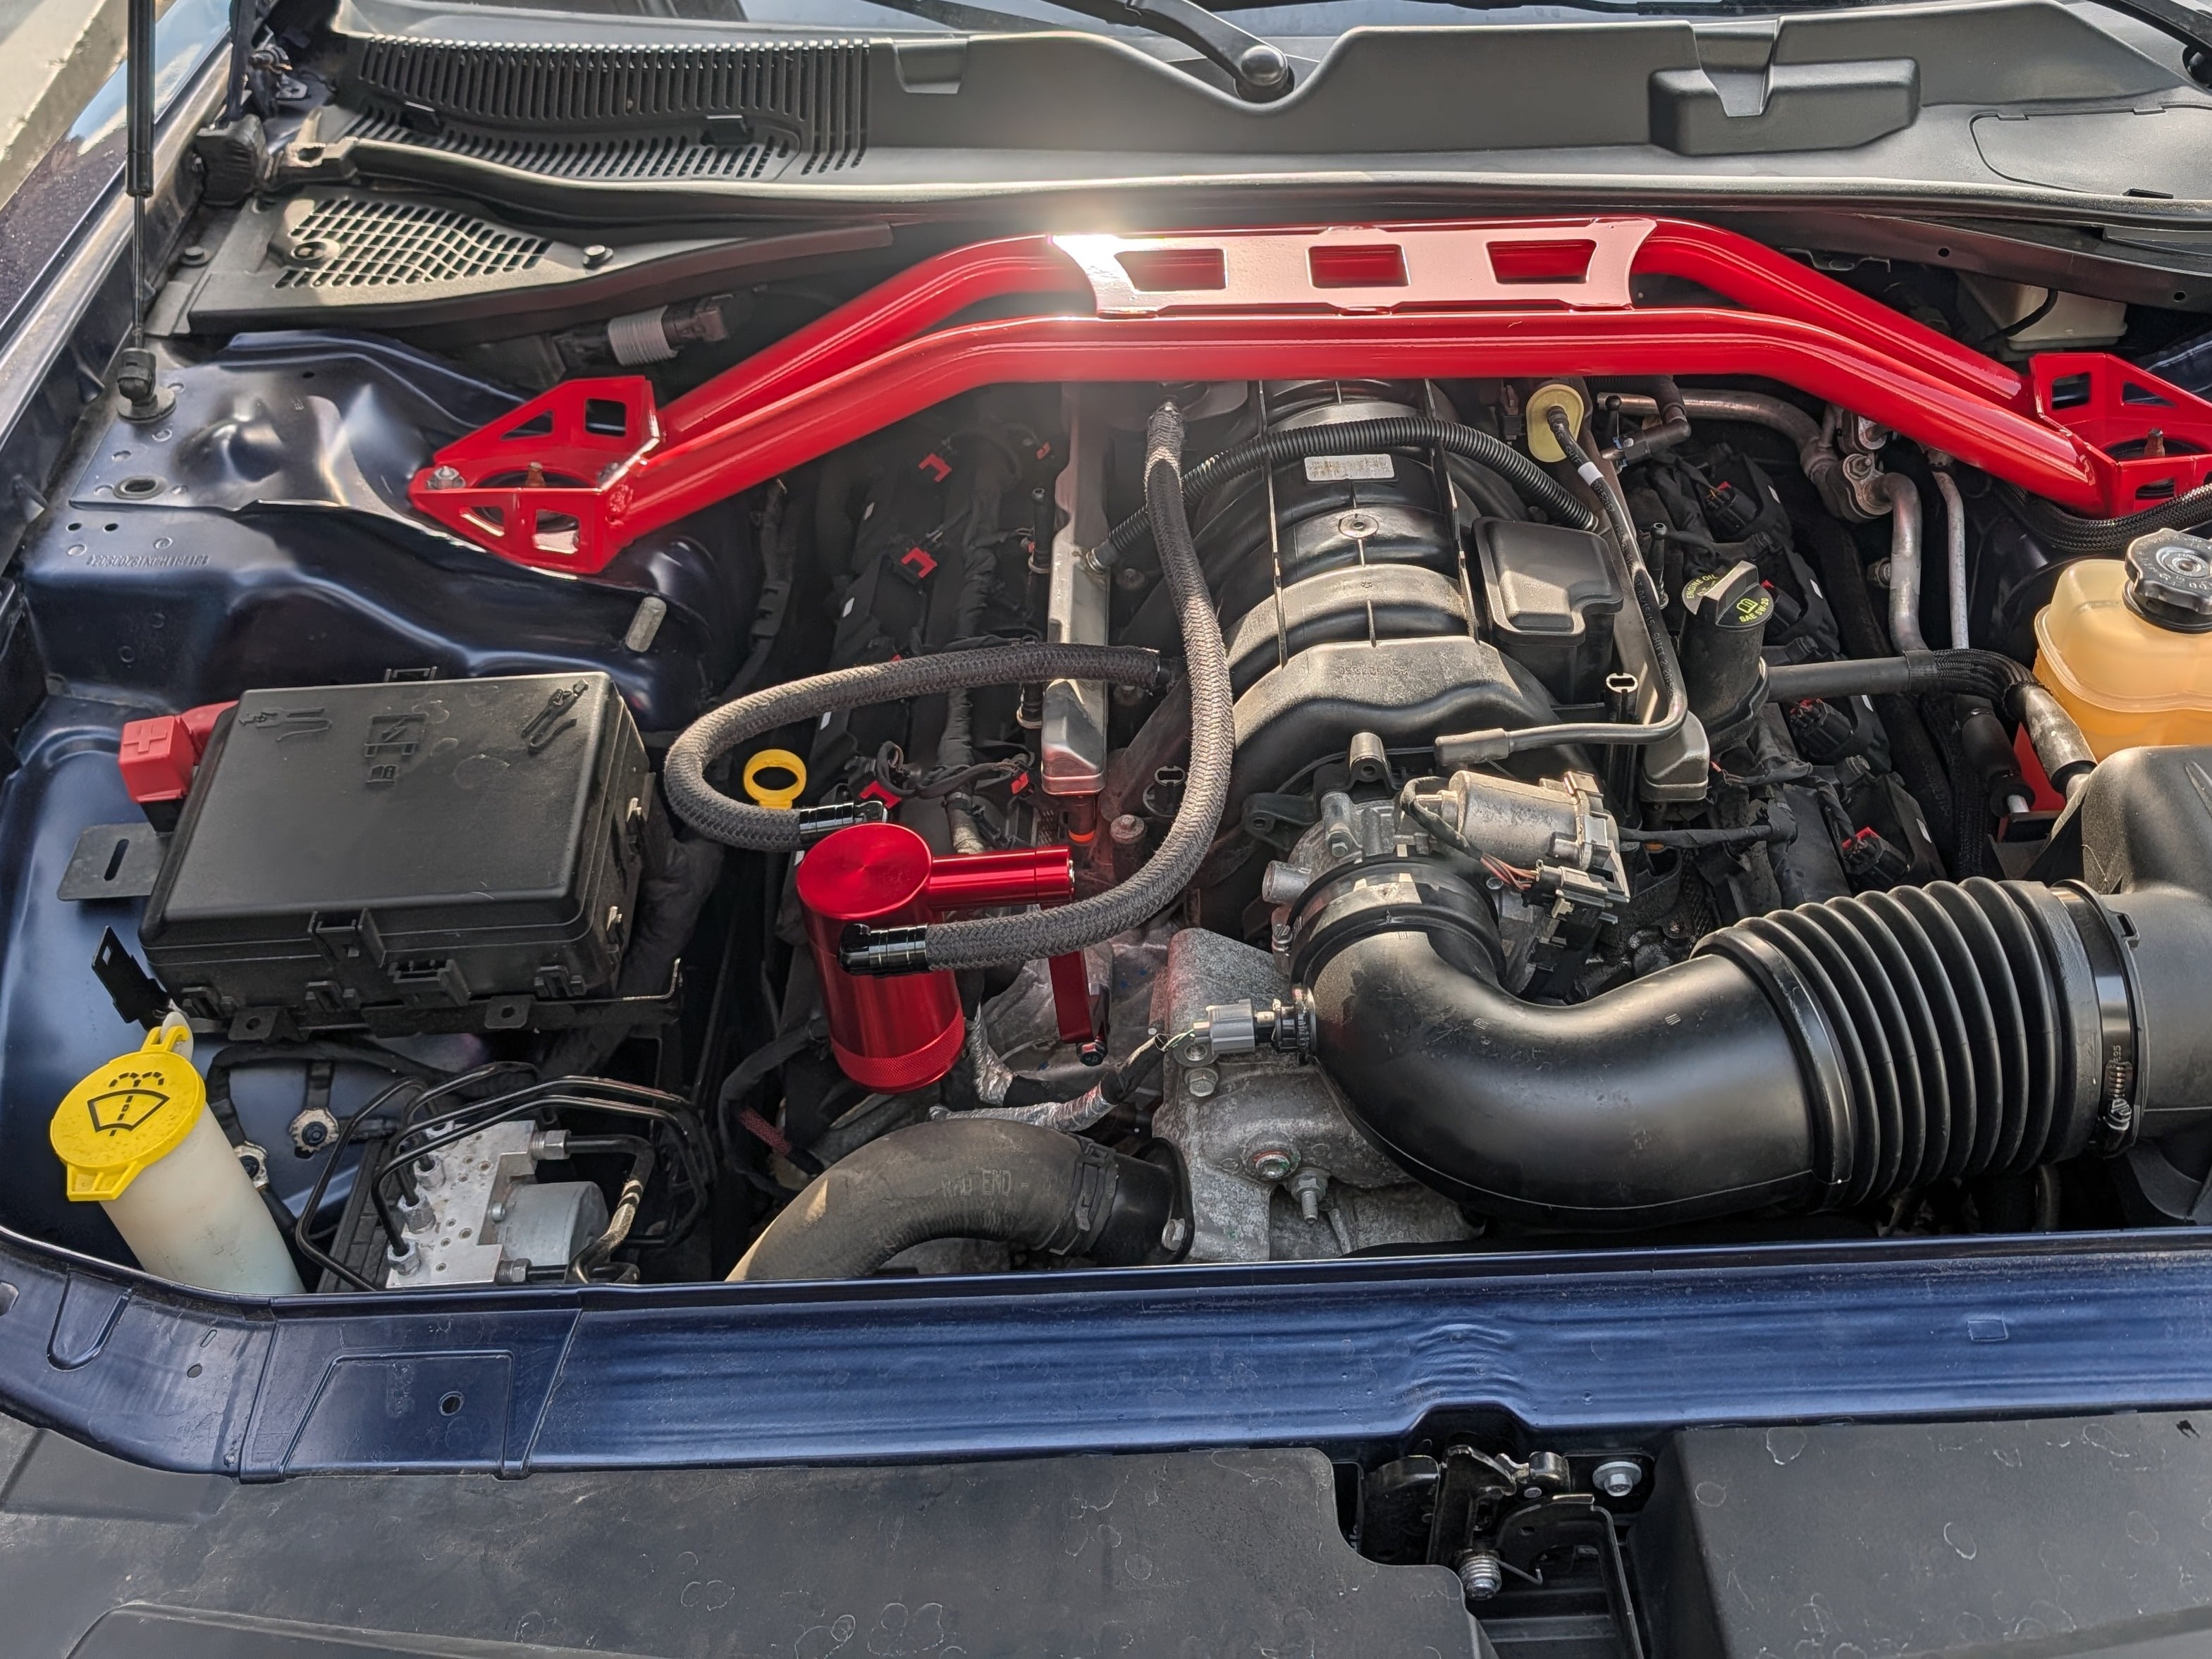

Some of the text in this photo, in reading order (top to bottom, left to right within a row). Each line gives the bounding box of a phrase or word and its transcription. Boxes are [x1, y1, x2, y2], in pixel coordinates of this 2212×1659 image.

[1686, 579, 1704, 599] ENGINE
[1739, 598, 1769, 622] SAE 5W-20
[1652, 631, 1666, 657] SHIFT
[981, 1169, 1012, 1197] END
